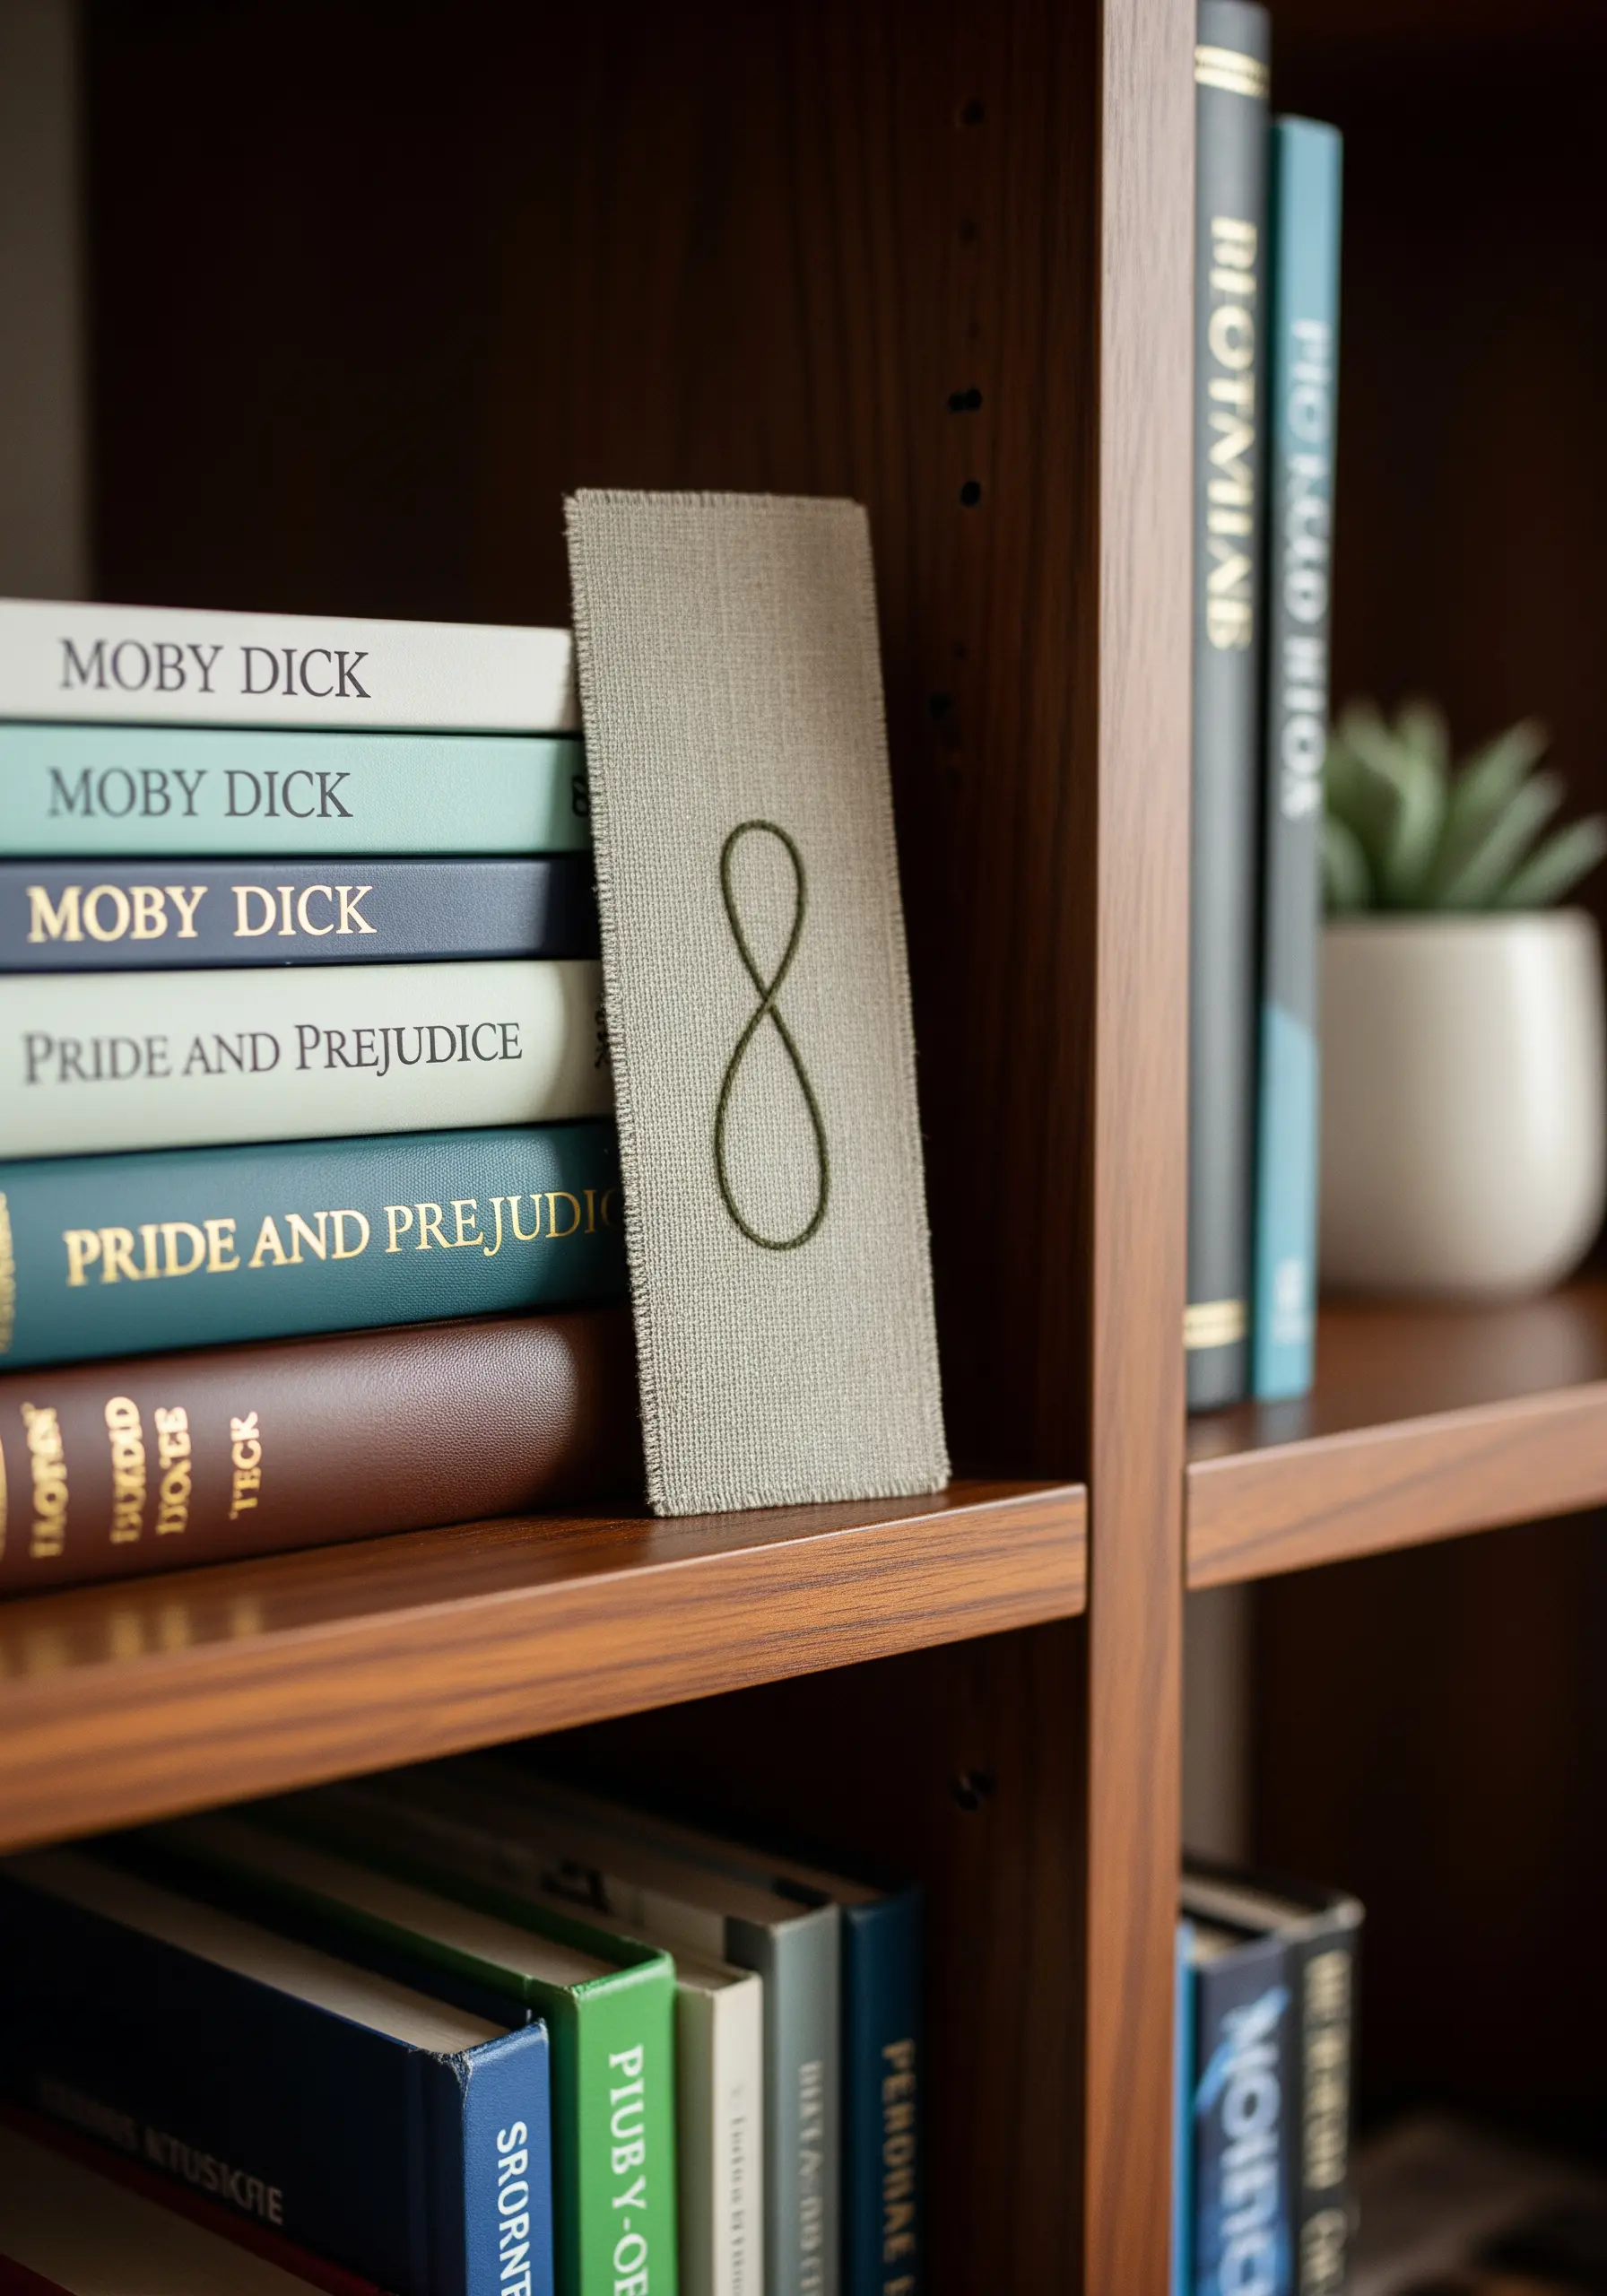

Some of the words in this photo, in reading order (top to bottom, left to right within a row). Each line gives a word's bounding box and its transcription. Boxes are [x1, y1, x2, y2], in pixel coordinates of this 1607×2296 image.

[58, 638, 223, 693] MOBY
[240, 646, 372, 699] DICK
[48, 766, 208, 819] MOBY
[223, 770, 353, 818] DICK
[26, 884, 208, 943] MOBY
[231, 884, 378, 936] DICK
[181, 1032, 281, 1075] AND
[63, 1217, 237, 1287] PRIDE
[247, 1208, 370, 1269] AND
